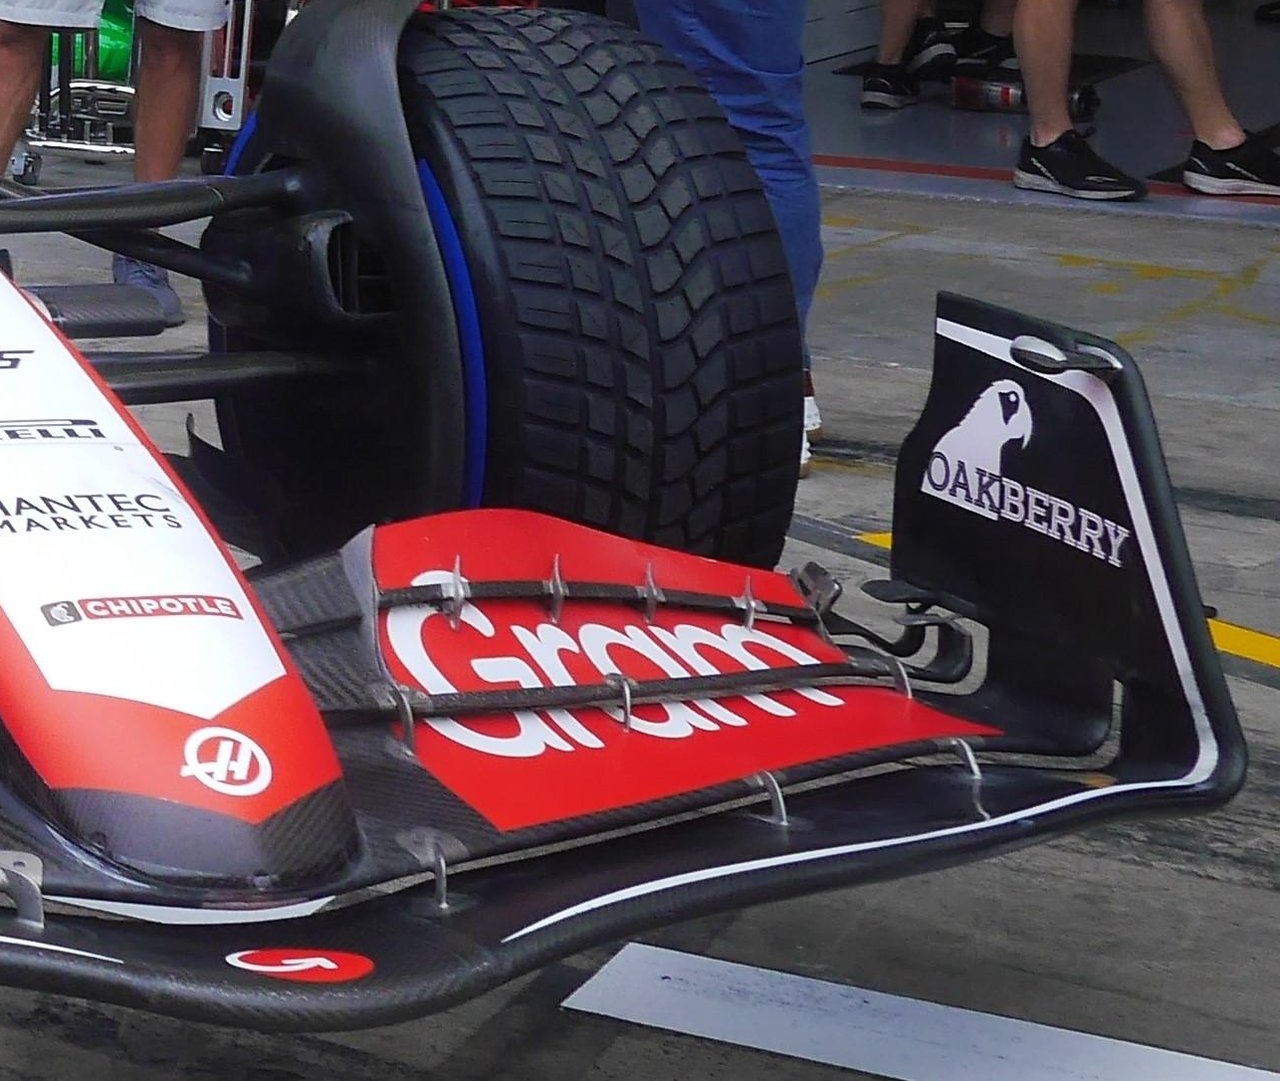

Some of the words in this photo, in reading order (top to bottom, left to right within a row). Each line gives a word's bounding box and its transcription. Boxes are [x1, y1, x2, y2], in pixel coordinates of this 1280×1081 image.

[927, 451, 1131, 568] OAKBERRY
[86, 597, 237, 617] CHIPOTLE
[387, 570, 846, 758] Gram
